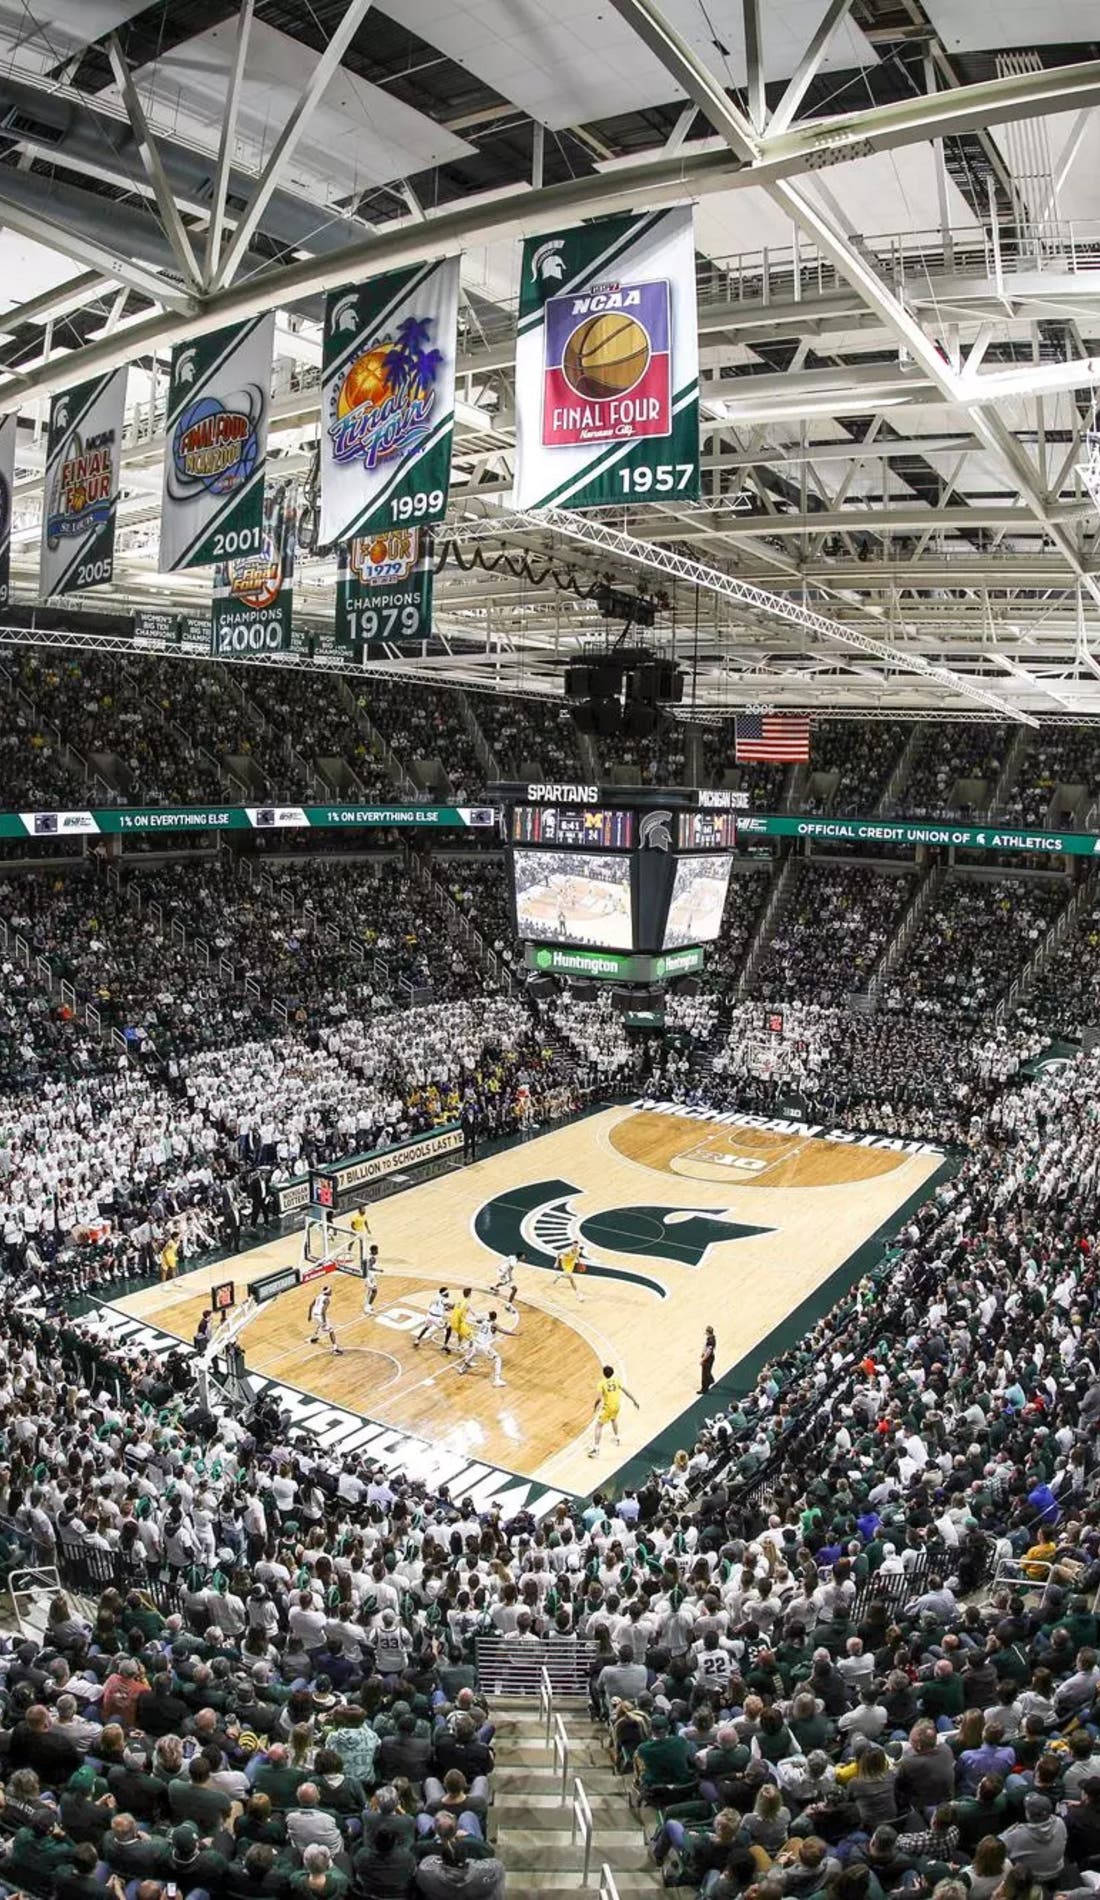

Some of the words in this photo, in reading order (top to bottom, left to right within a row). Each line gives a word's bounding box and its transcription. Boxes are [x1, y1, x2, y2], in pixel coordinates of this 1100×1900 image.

[572, 289, 641, 315] NCAA
[328, 374, 409, 458] Final
[553, 404, 603, 431] FINAL
[610, 397, 660, 424] FOUR
[62, 448, 110, 483] FINAL
[619, 463, 695, 493] 1957
[390, 489, 444, 521] 1999
[213, 527, 260, 555] 2001
[77, 558, 112, 585] 2005
[366, 562, 402, 577] 1979
[346, 592, 421, 611] CHAMPIONS
[219, 608, 282, 625] CHAMPIONS
[346, 606, 419, 639] 1979
[219, 622, 282, 652] 2000
[527, 784, 598, 802] SPARTANS
[119, 816, 132, 827] 1%
[135, 815, 148, 826] ON
[150, 814, 207, 827] EVERYTHING
[208, 813, 230, 825] ELSE
[327, 812, 339, 822] 1%
[341, 812, 355, 822] ON
[356, 812, 414, 822] EVERYTHING
[416, 811, 439, 822] ELSE
[585, 812, 603, 828] M
[798, 823, 855, 837] OFFICIAL
[858, 827, 902, 840] CREDIT
[907, 829, 949, 842] UNION
[952, 832, 971, 843] OF
[992, 835, 1063, 850] ATHLETICS
[553, 952, 618, 974] Huntington
[627, 1099, 824, 1137] MICHIGAN
[824, 1129, 945, 1157] STATE
[346, 1163, 380, 1183] BILLION
[392, 1144, 430, 1166] SCHOOLS
[431, 1138, 451, 1152] LAST
[284, 1194, 308, 1208] LOTTERY
[704, 1657, 726, 1675] 22
